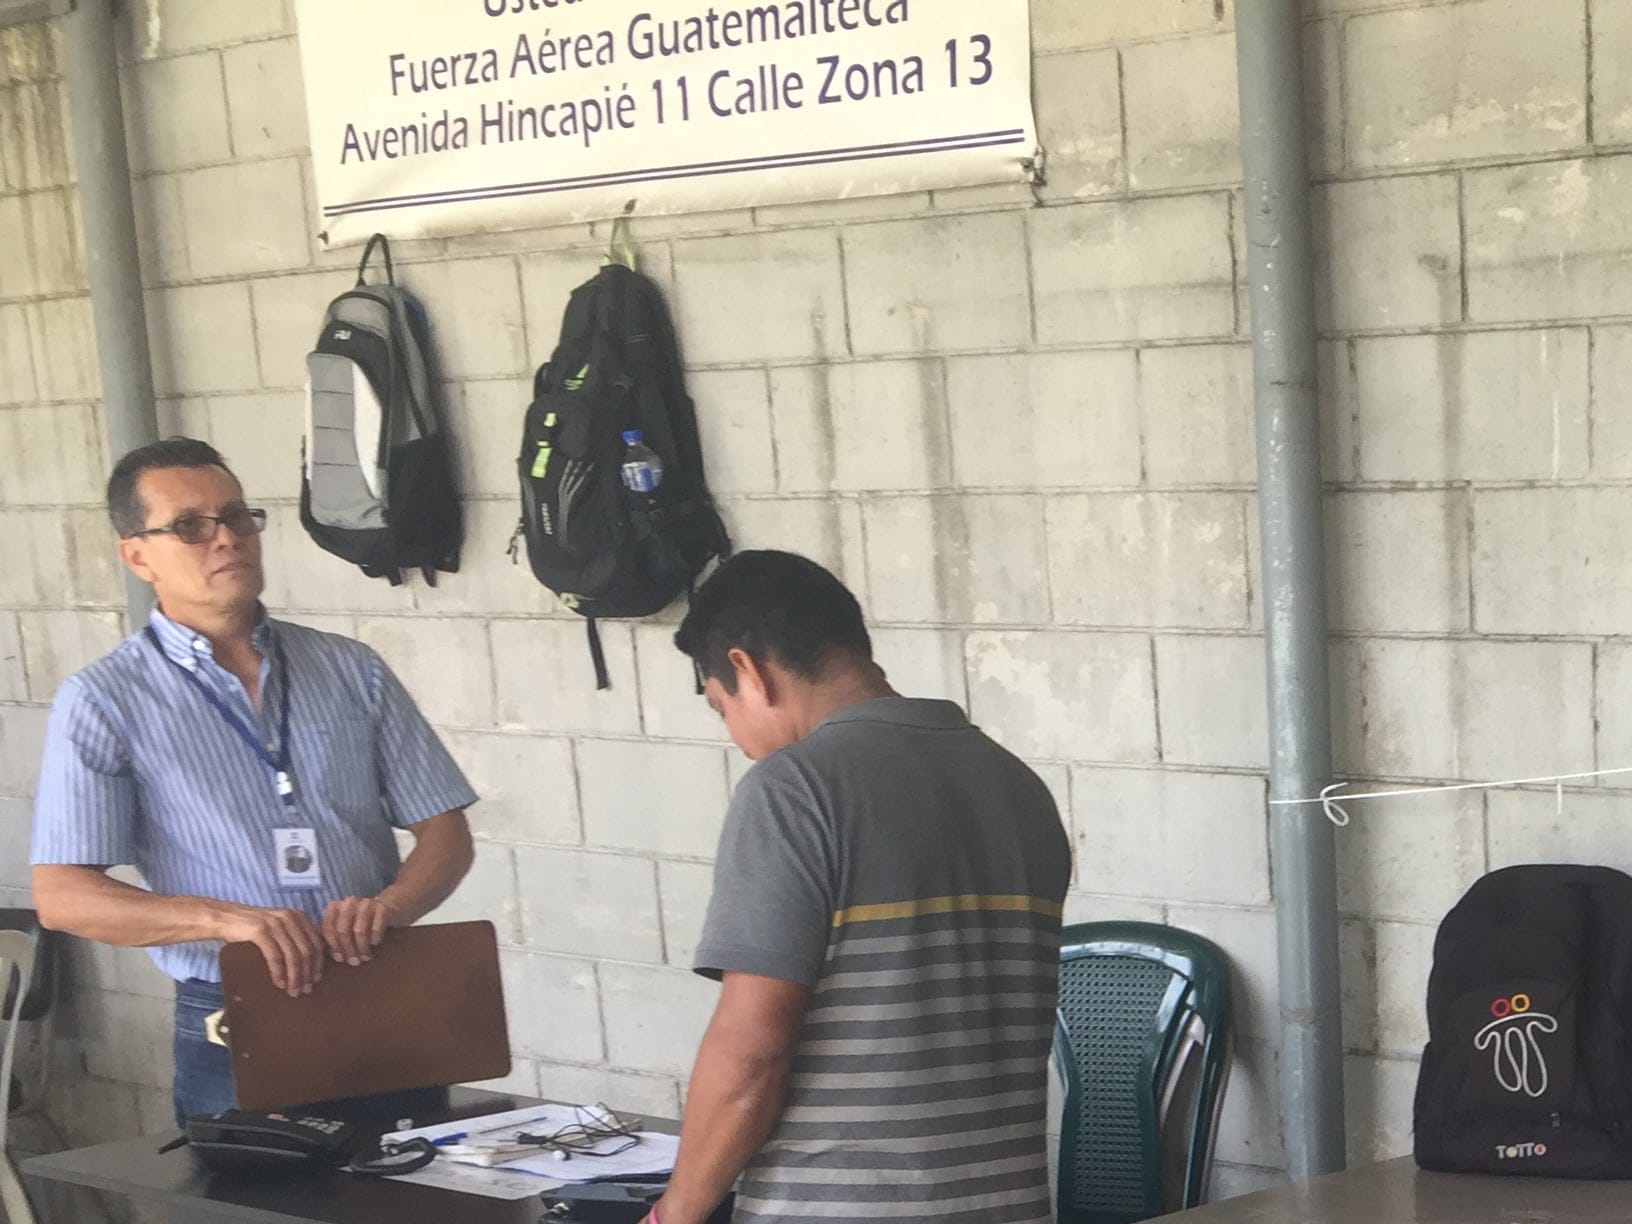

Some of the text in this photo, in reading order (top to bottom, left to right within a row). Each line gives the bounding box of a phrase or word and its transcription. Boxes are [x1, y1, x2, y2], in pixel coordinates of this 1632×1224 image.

[389, 0, 910, 97] Fuerza Aérea Guatemalteca
[340, 34, 994, 166] Avenida Hincapié 11 Calle Zona 13
[1495, 1142, 1547, 1159] TOTTO
